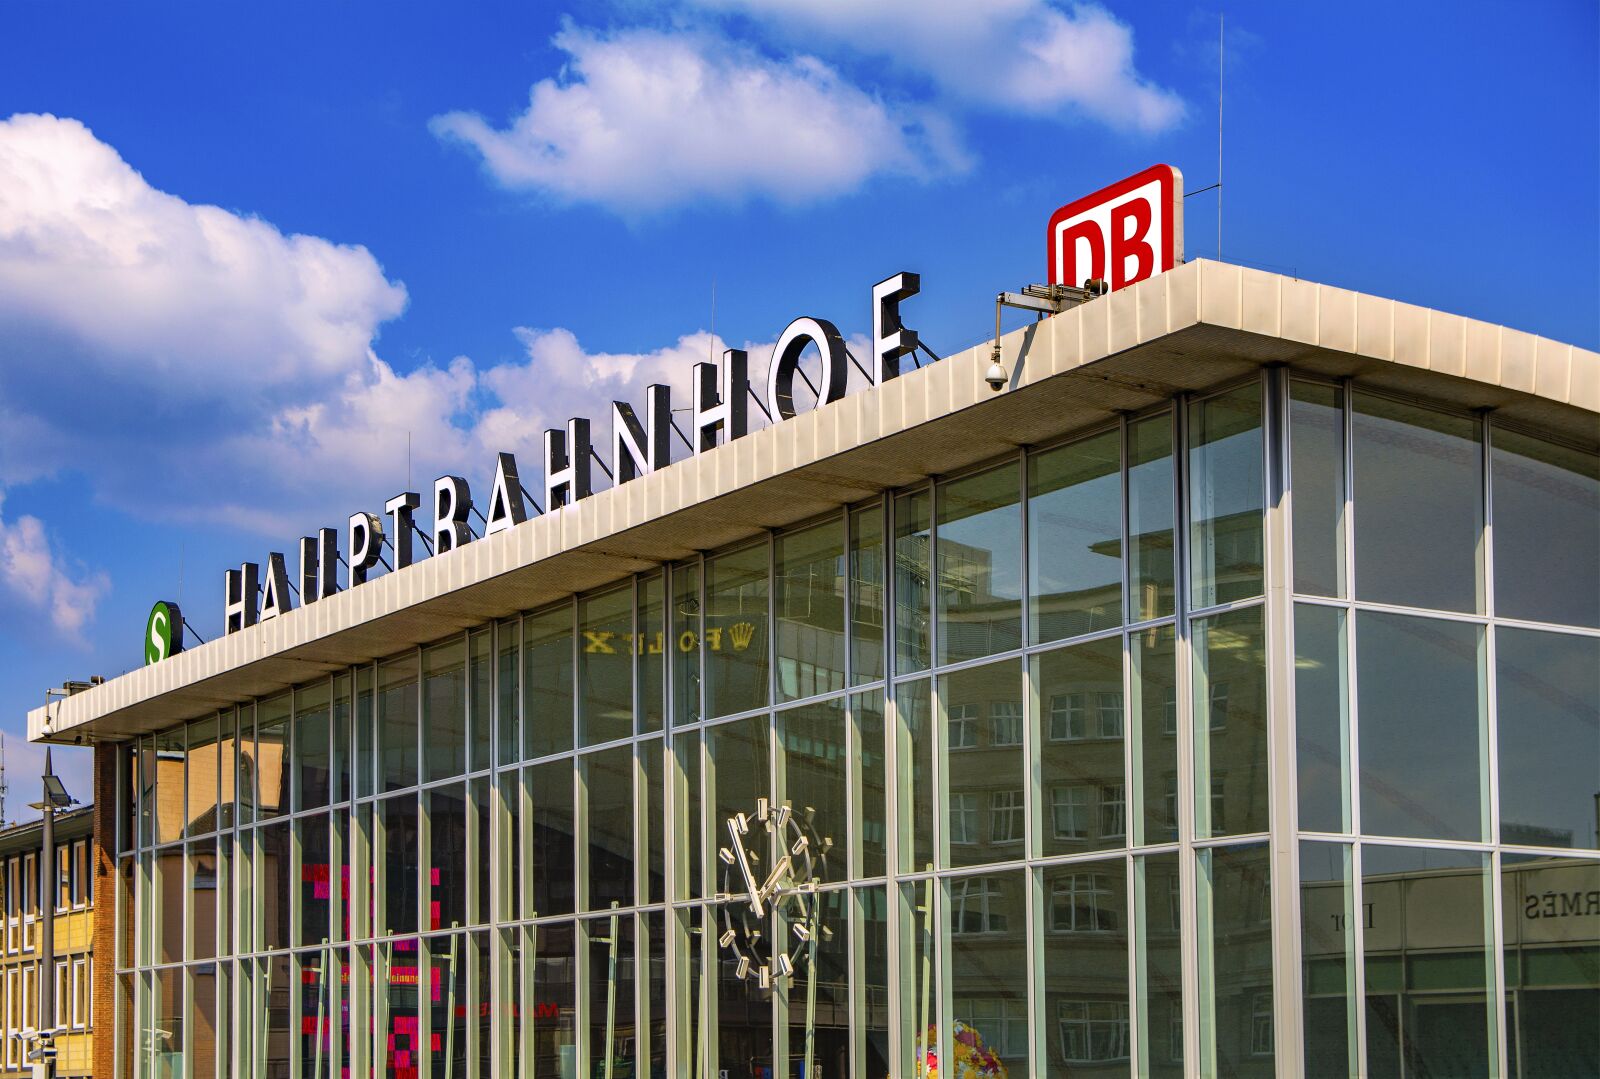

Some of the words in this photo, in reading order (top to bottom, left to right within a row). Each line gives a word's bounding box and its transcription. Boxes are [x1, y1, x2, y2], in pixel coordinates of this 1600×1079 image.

[1062, 197, 1154, 293] DB
[224, 271, 921, 637] HAUPTBAHNHOF
[149, 611, 167, 664] S
